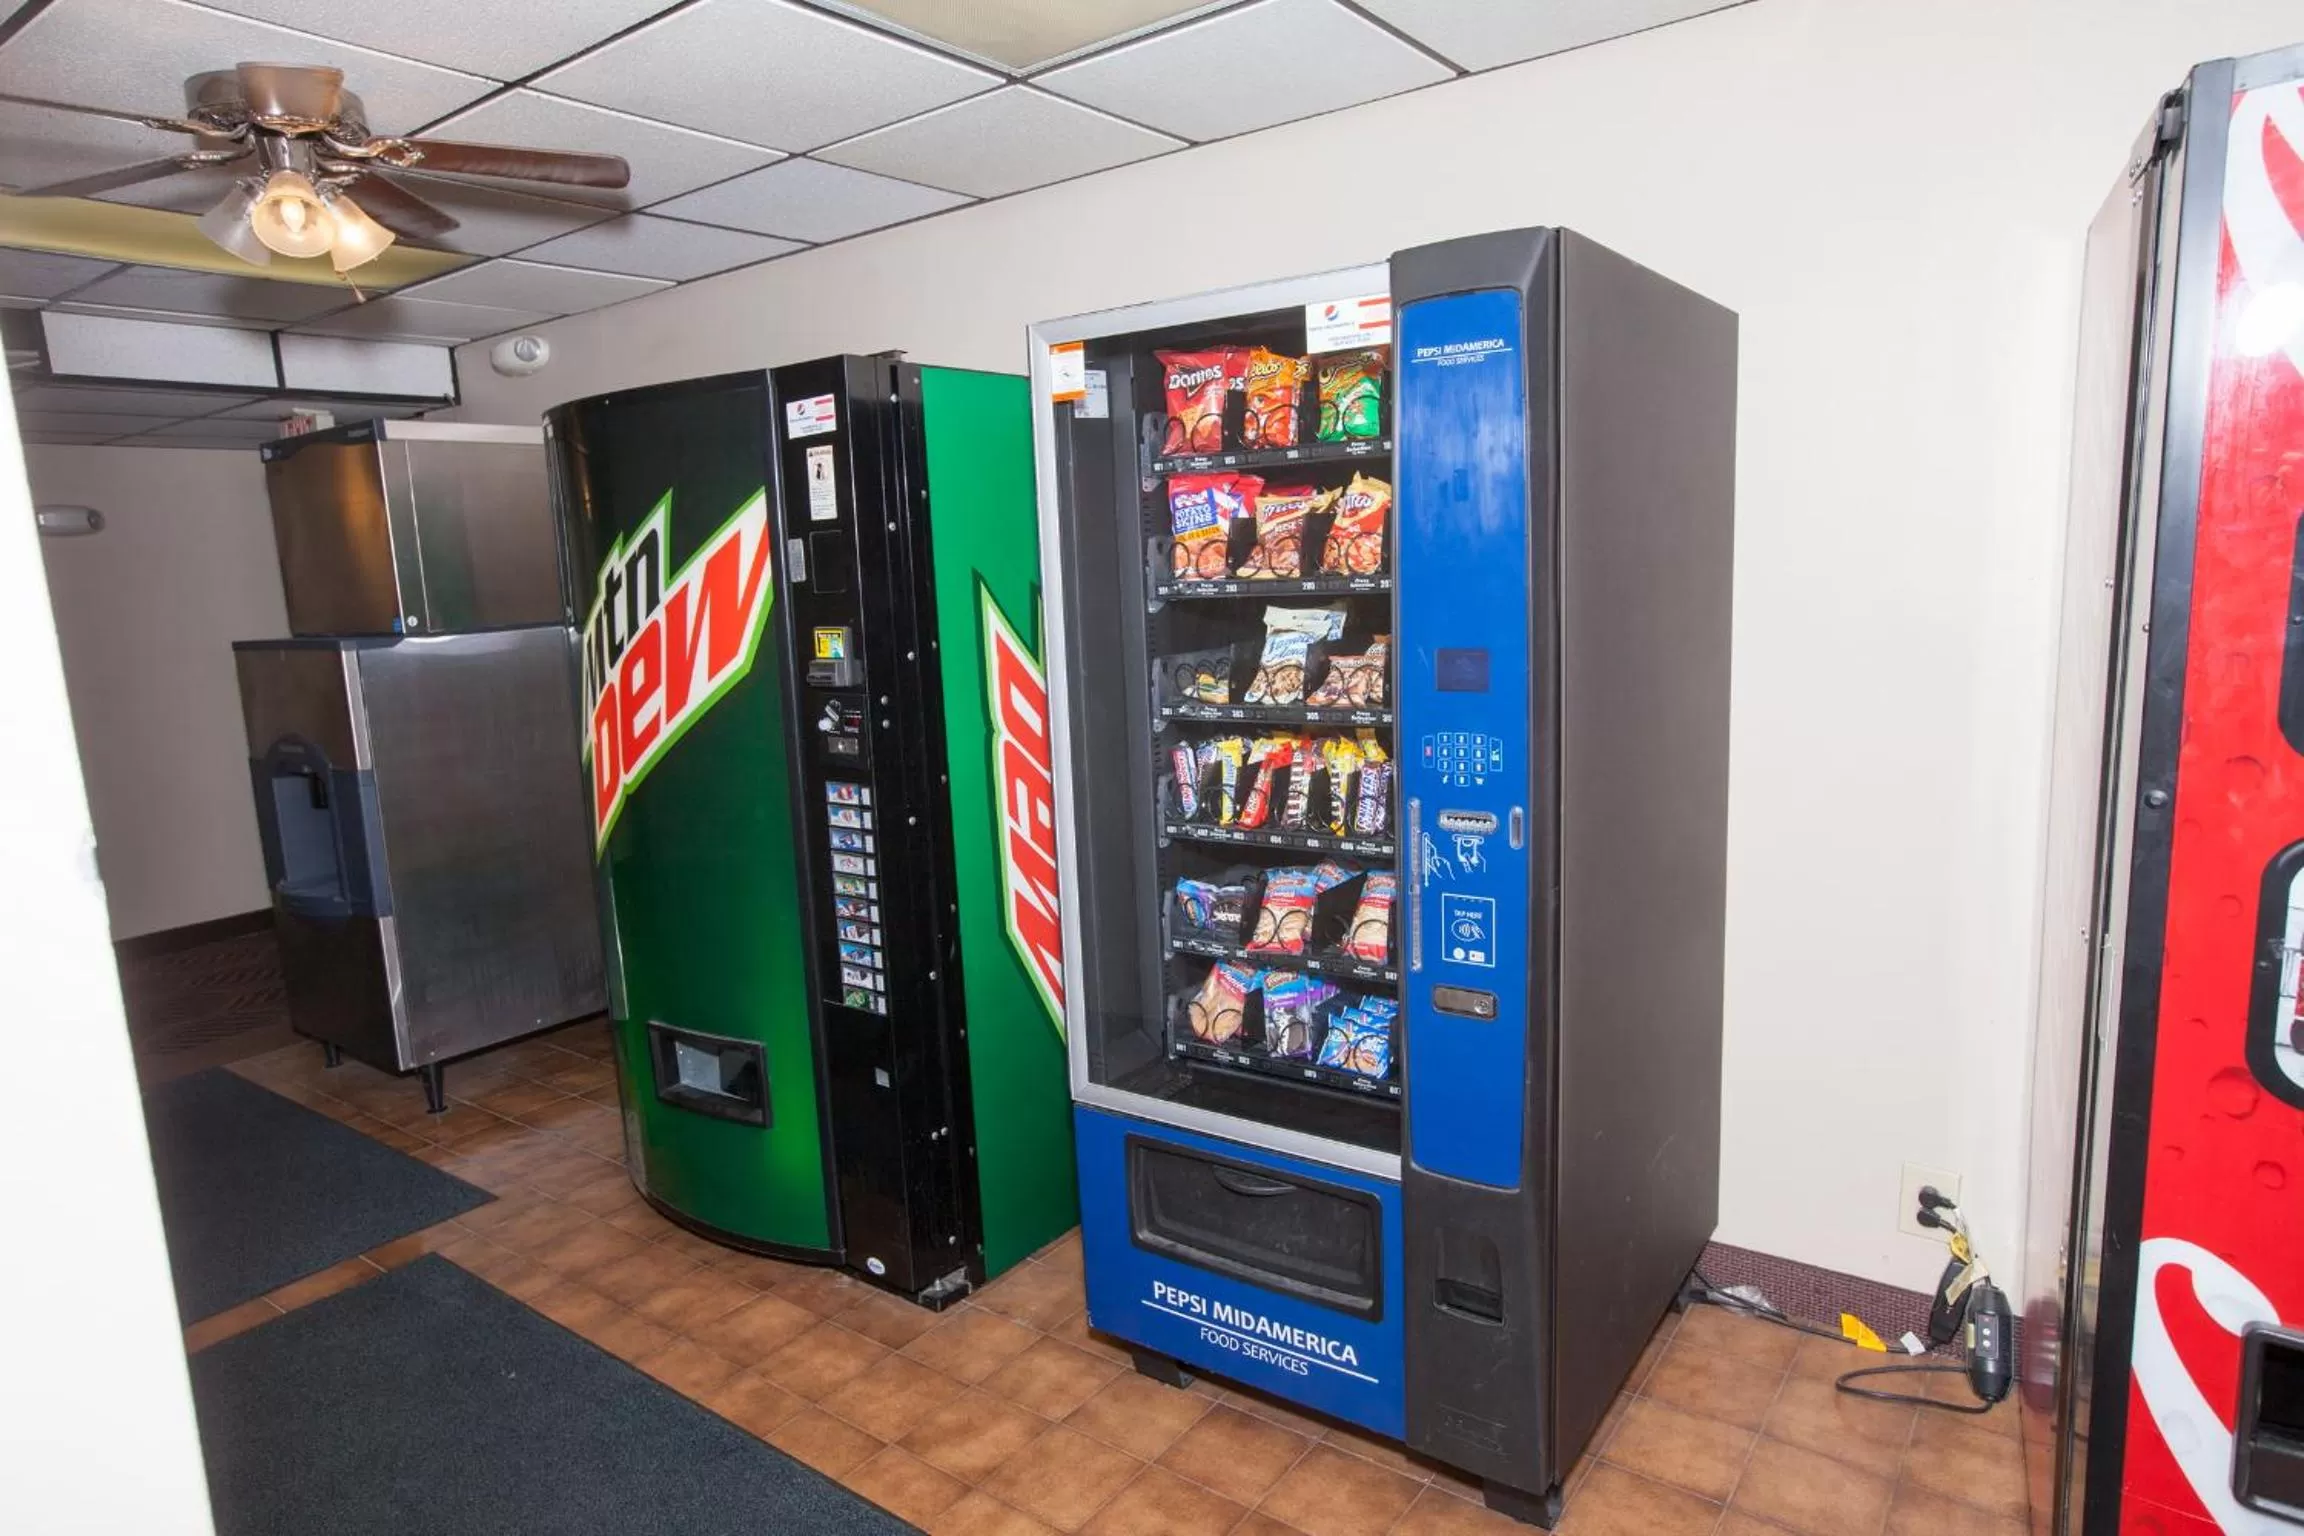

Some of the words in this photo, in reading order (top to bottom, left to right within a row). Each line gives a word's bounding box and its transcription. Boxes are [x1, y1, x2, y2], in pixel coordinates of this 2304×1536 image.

[1176, 511, 1213, 530] SKINS
[1152, 1280, 1207, 1316] PEPSI
[1213, 1301, 1359, 1366] MIDAMERICA
[1200, 1326, 1240, 1351] FOOD
[1242, 1341, 1309, 1376] SERVICES
